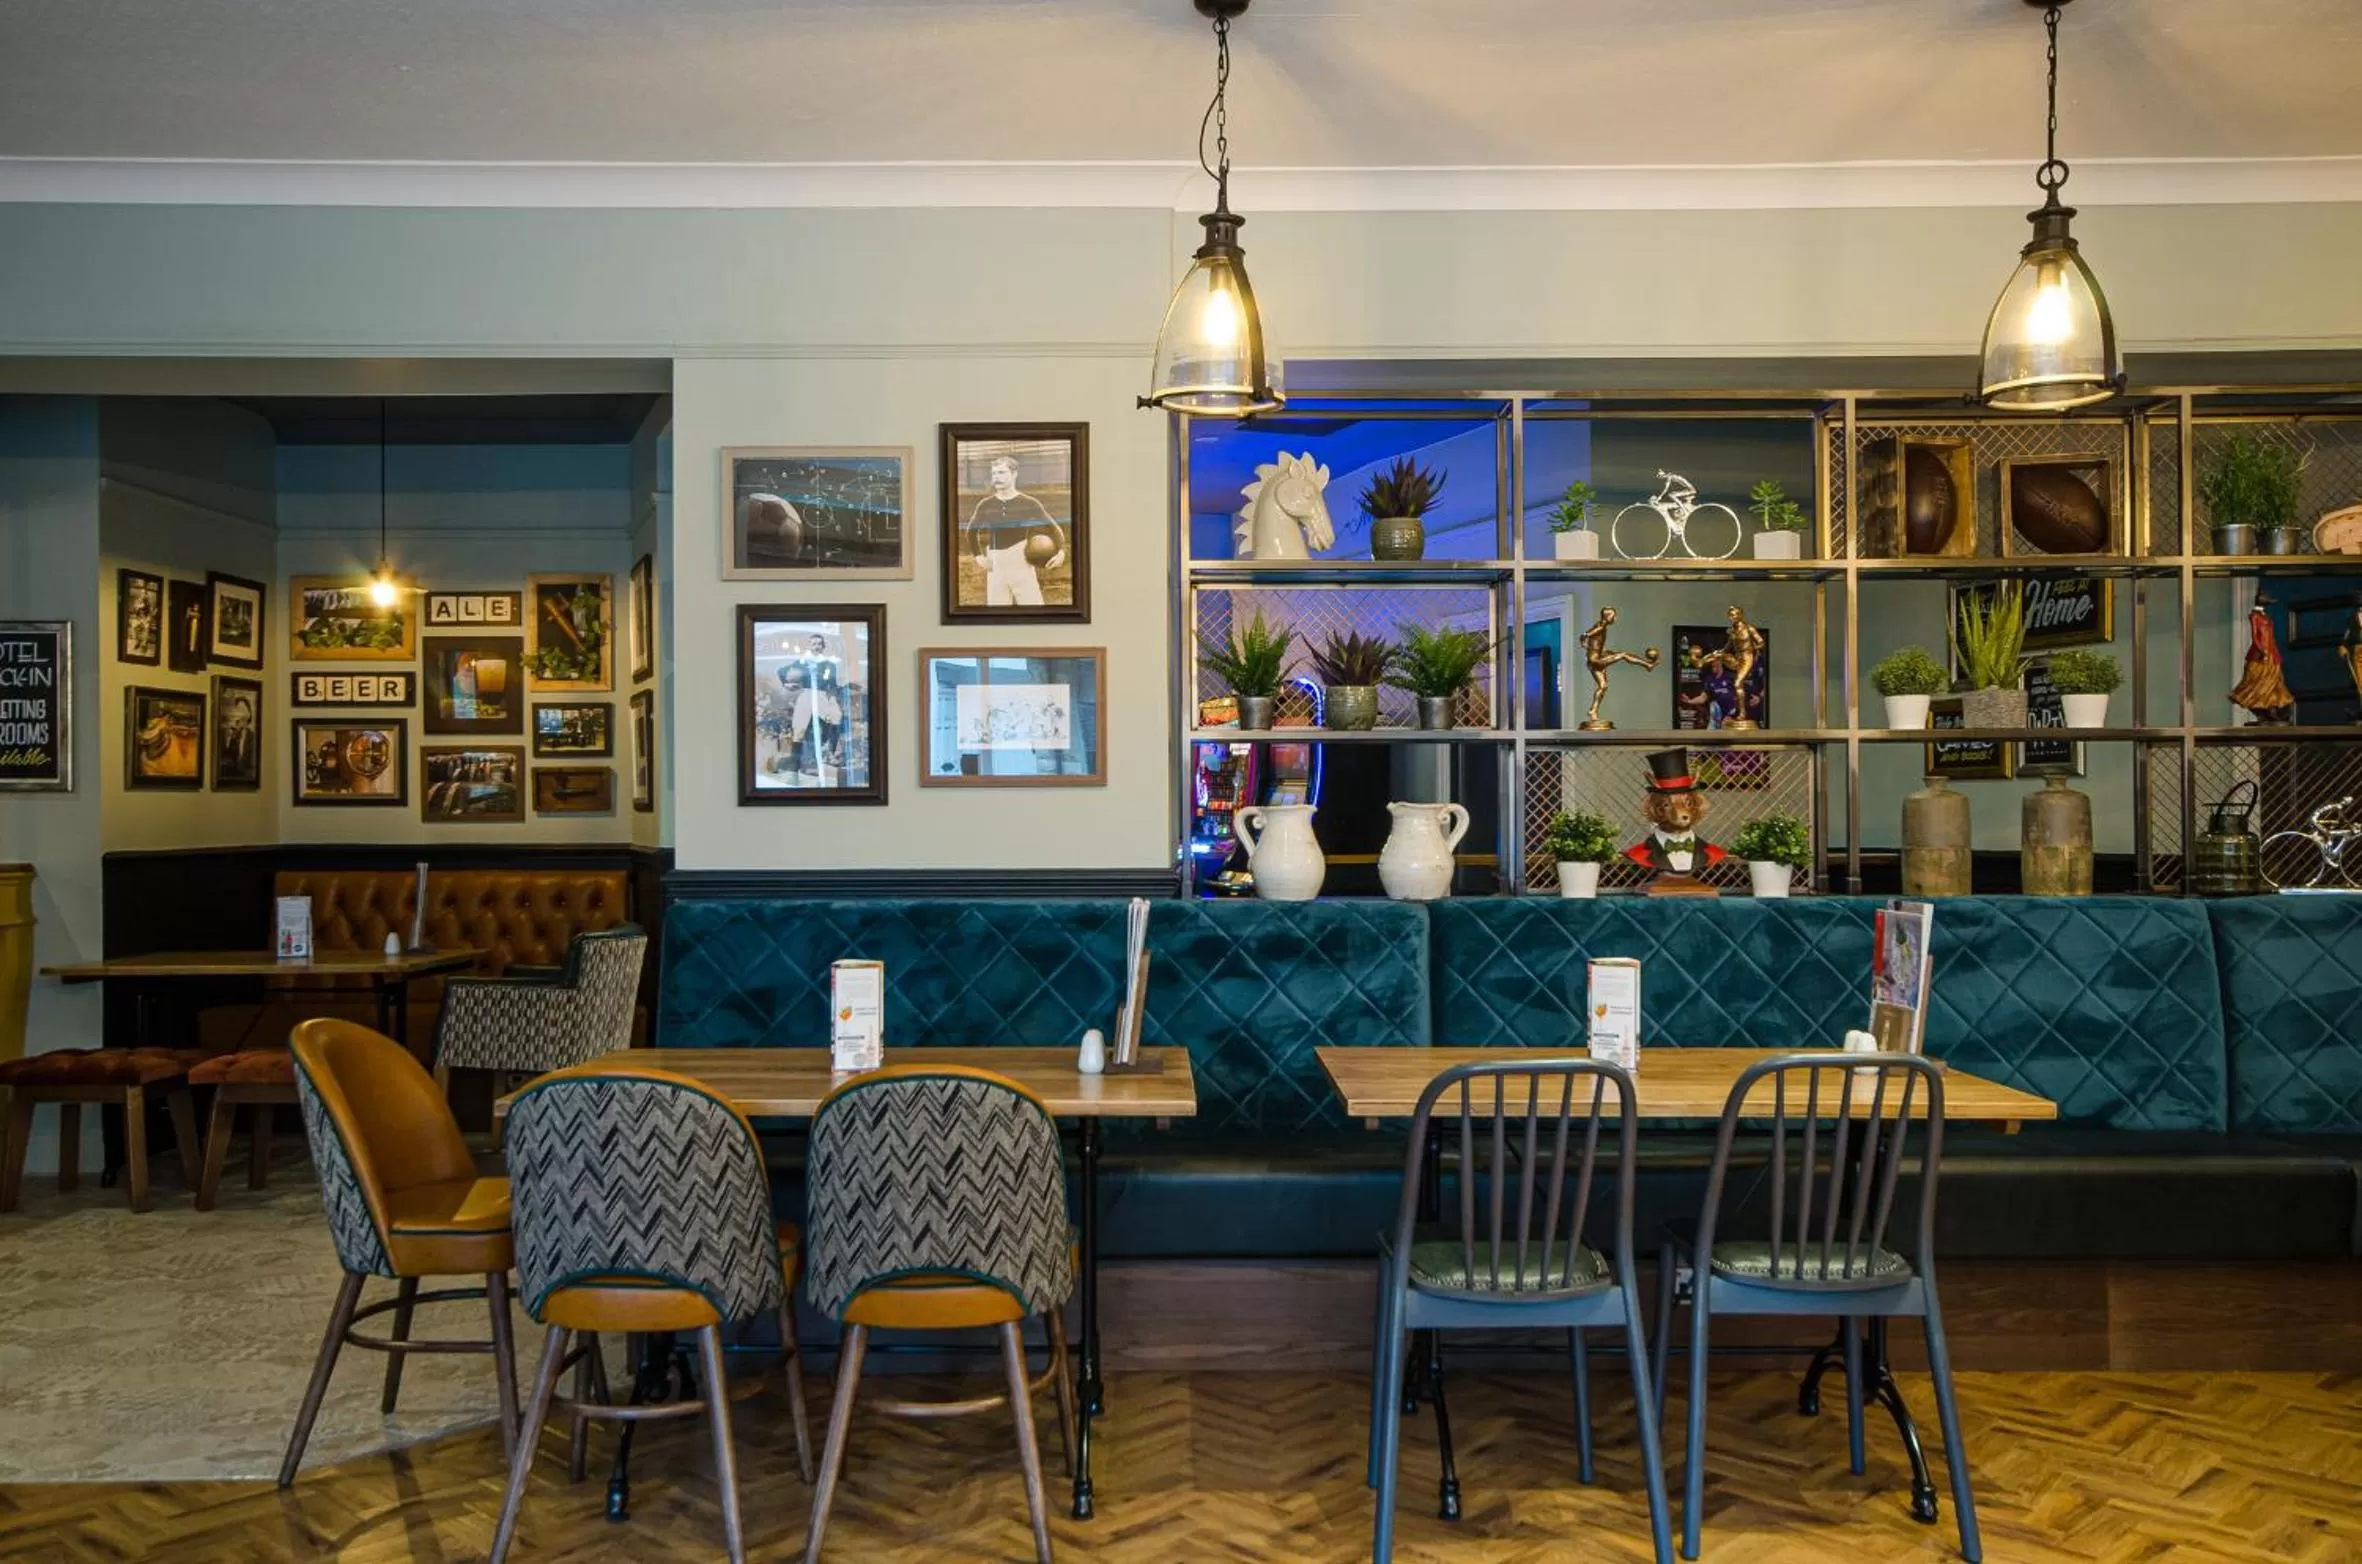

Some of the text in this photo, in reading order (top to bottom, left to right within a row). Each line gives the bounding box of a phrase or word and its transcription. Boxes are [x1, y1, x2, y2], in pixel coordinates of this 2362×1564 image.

[436, 600, 505, 618] ALE
[2025, 579, 2094, 629] Home
[304, 680, 398, 697] BEER
[0, 699, 46, 719] ETTING
